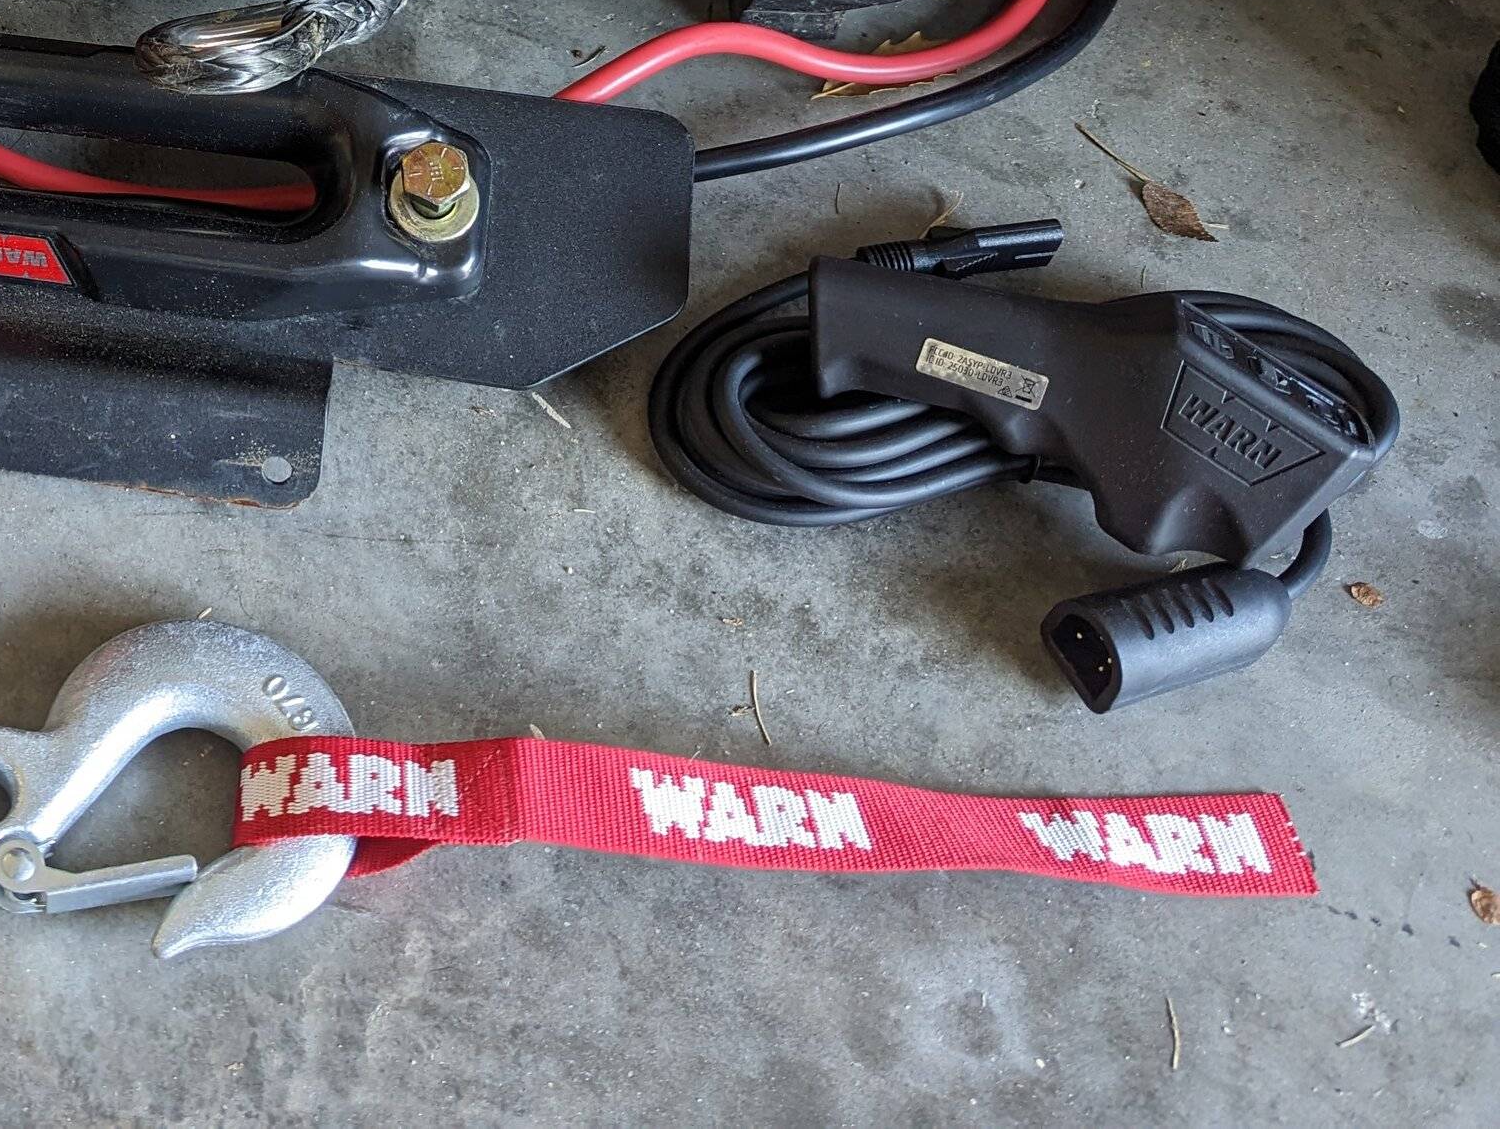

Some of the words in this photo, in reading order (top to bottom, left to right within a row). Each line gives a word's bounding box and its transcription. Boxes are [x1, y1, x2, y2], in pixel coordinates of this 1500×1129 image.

[1178, 393, 1282, 470] WARN
[240, 752, 460, 822] WARN
[629, 767, 872, 852] WARN
[1016, 808, 1274, 874] WARN
